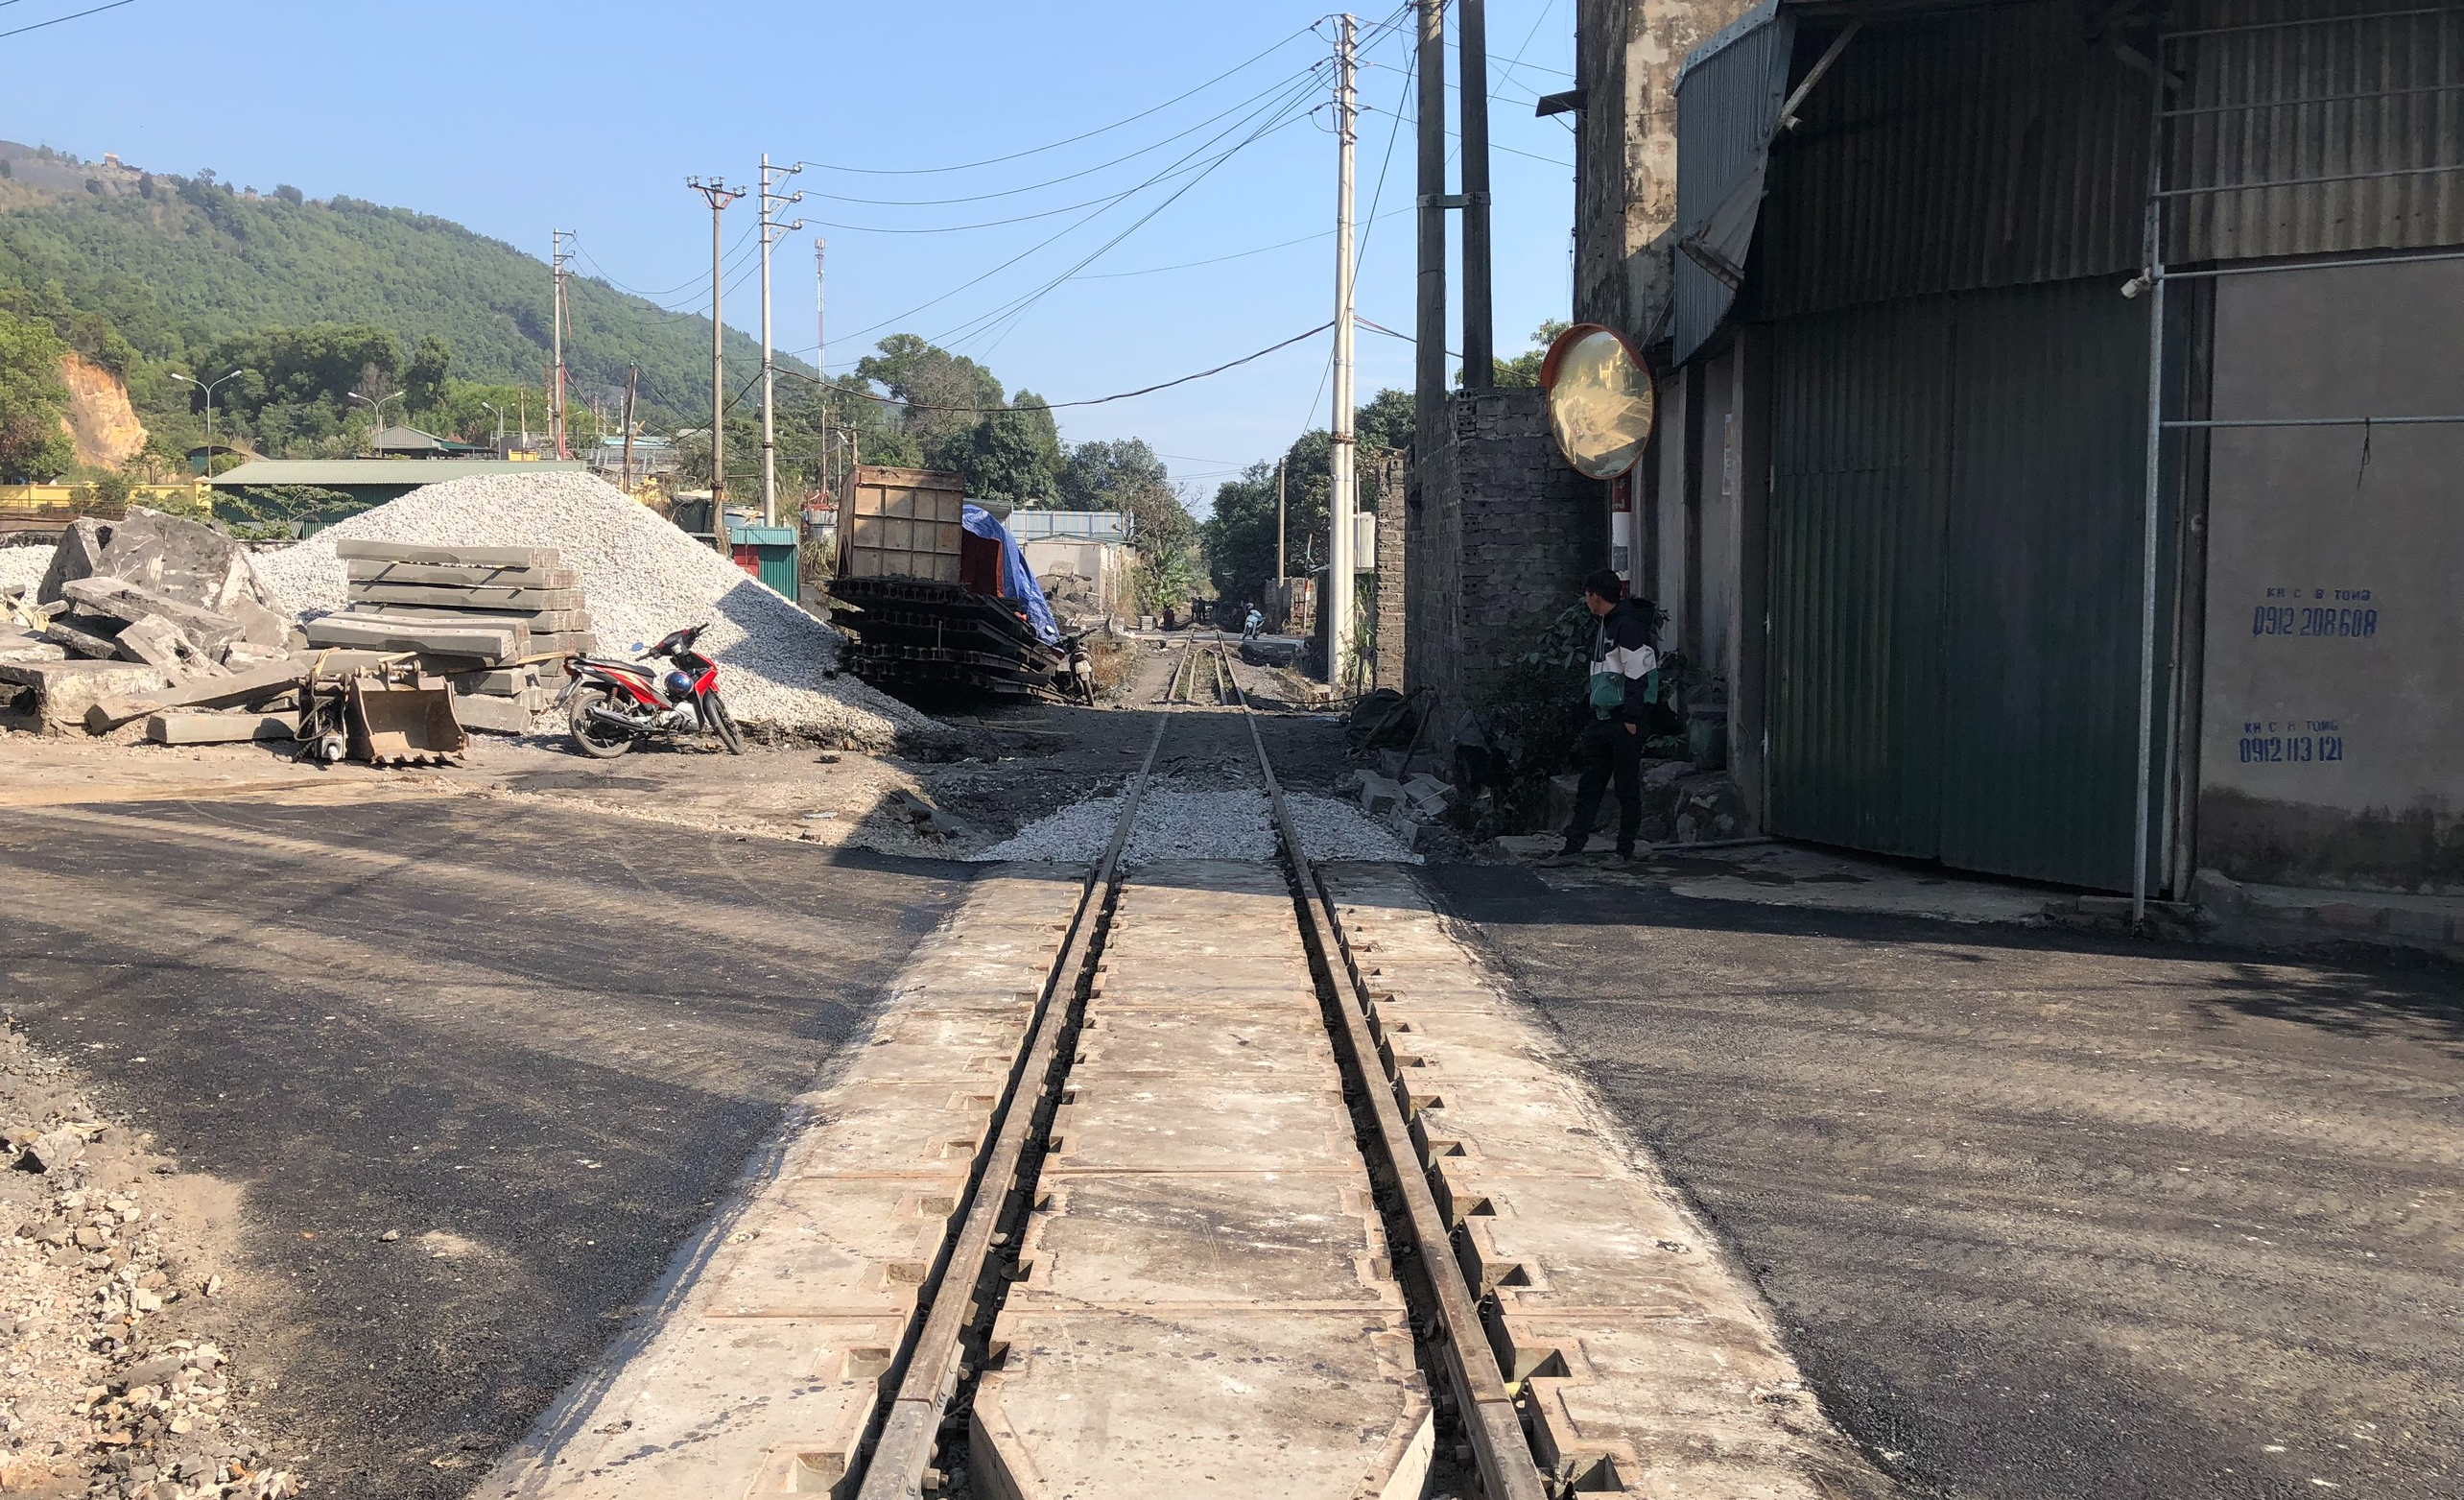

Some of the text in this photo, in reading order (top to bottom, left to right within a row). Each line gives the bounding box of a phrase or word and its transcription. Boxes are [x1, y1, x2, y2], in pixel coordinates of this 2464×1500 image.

[2253, 606, 2294, 637] 0912
[2239, 736, 2343, 763] 0912 113 121
